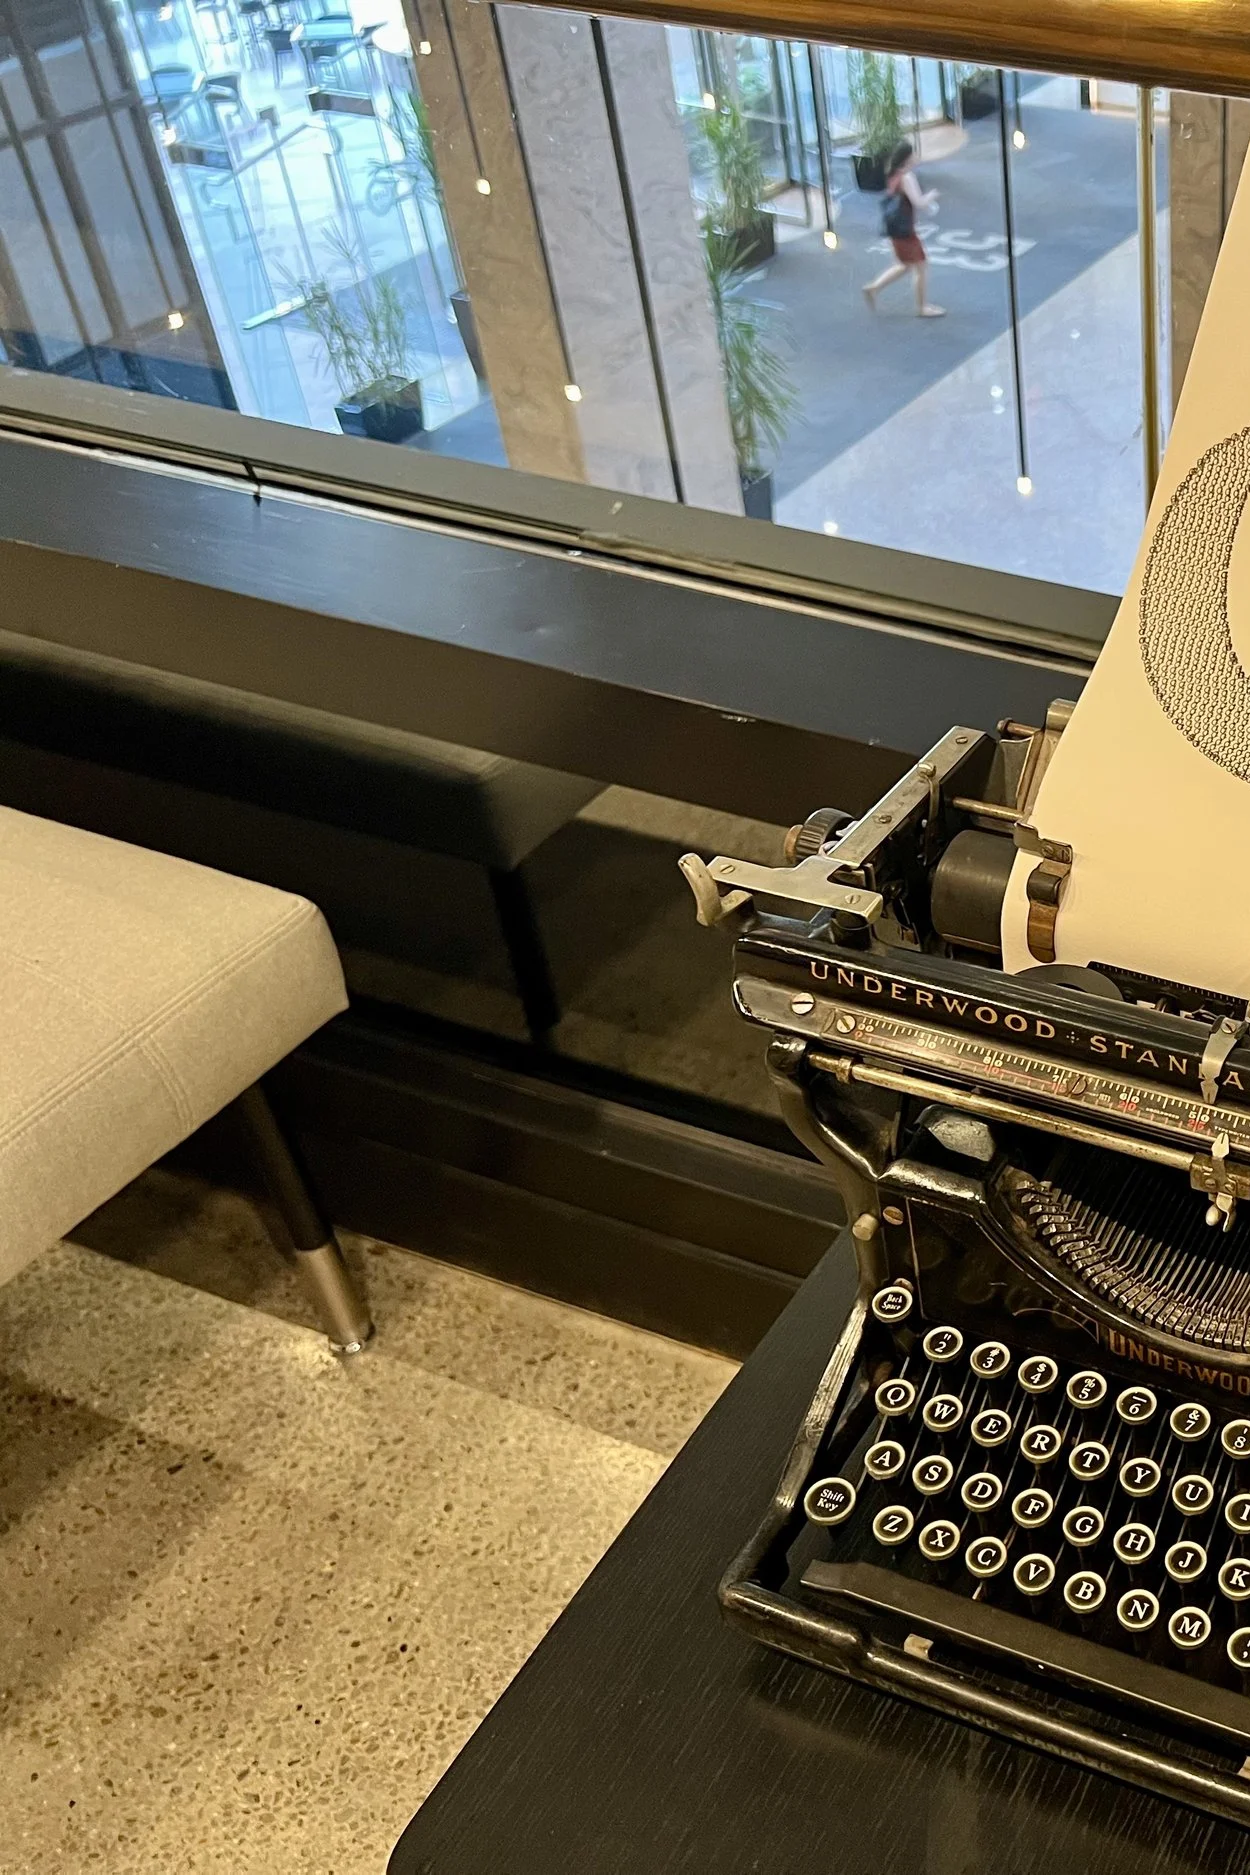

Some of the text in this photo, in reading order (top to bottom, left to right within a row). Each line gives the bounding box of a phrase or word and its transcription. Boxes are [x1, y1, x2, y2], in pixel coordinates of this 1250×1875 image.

[810, 961, 1057, 1039] UNDERWOOD
[1119, 1092, 1140, 1104] 60
[1188, 1110, 1210, 1123] 50
[881, 1301, 902, 1311] Space
[886, 1293, 903, 1304] Back
[935, 1342, 947, 1353] 2
[983, 1357, 994, 1369] 3
[1031, 1373, 1042, 1384] 4
[886, 1387, 906, 1406] Q
[1080, 1388, 1091, 1400] 5
[935, 1402, 955, 1419] W
[1129, 1403, 1141, 1415] 6
[983, 1417, 1002, 1435] E
[1185, 1420, 1196, 1432] 7
[1030, 1434, 1050, 1451] R
[1234, 1436, 1246, 1449] 8
[874, 1451, 891, 1467] A
[1083, 1452, 1100, 1468] T
[925, 1465, 942, 1482] S
[1135, 1467, 1151, 1484] Y
[820, 1488, 845, 1502] Shift
[972, 1481, 993, 1499] D
[1185, 1484, 1204, 1501] U
[816, 1497, 840, 1512] Key
[1025, 1499, 1044, 1516] F
[884, 1515, 904, 1532] Z
[1075, 1517, 1094, 1534] G
[930, 1530, 951, 1547] X
[1125, 1533, 1146, 1552] H
[977, 1548, 997, 1566] C
[1178, 1552, 1195, 1568] J
[1028, 1563, 1046, 1581] V
[1230, 1569, 1250, 1587] K
[1076, 1581, 1095, 1599] B
[1127, 1600, 1150, 1620] N
[1178, 1616, 1203, 1637] M
